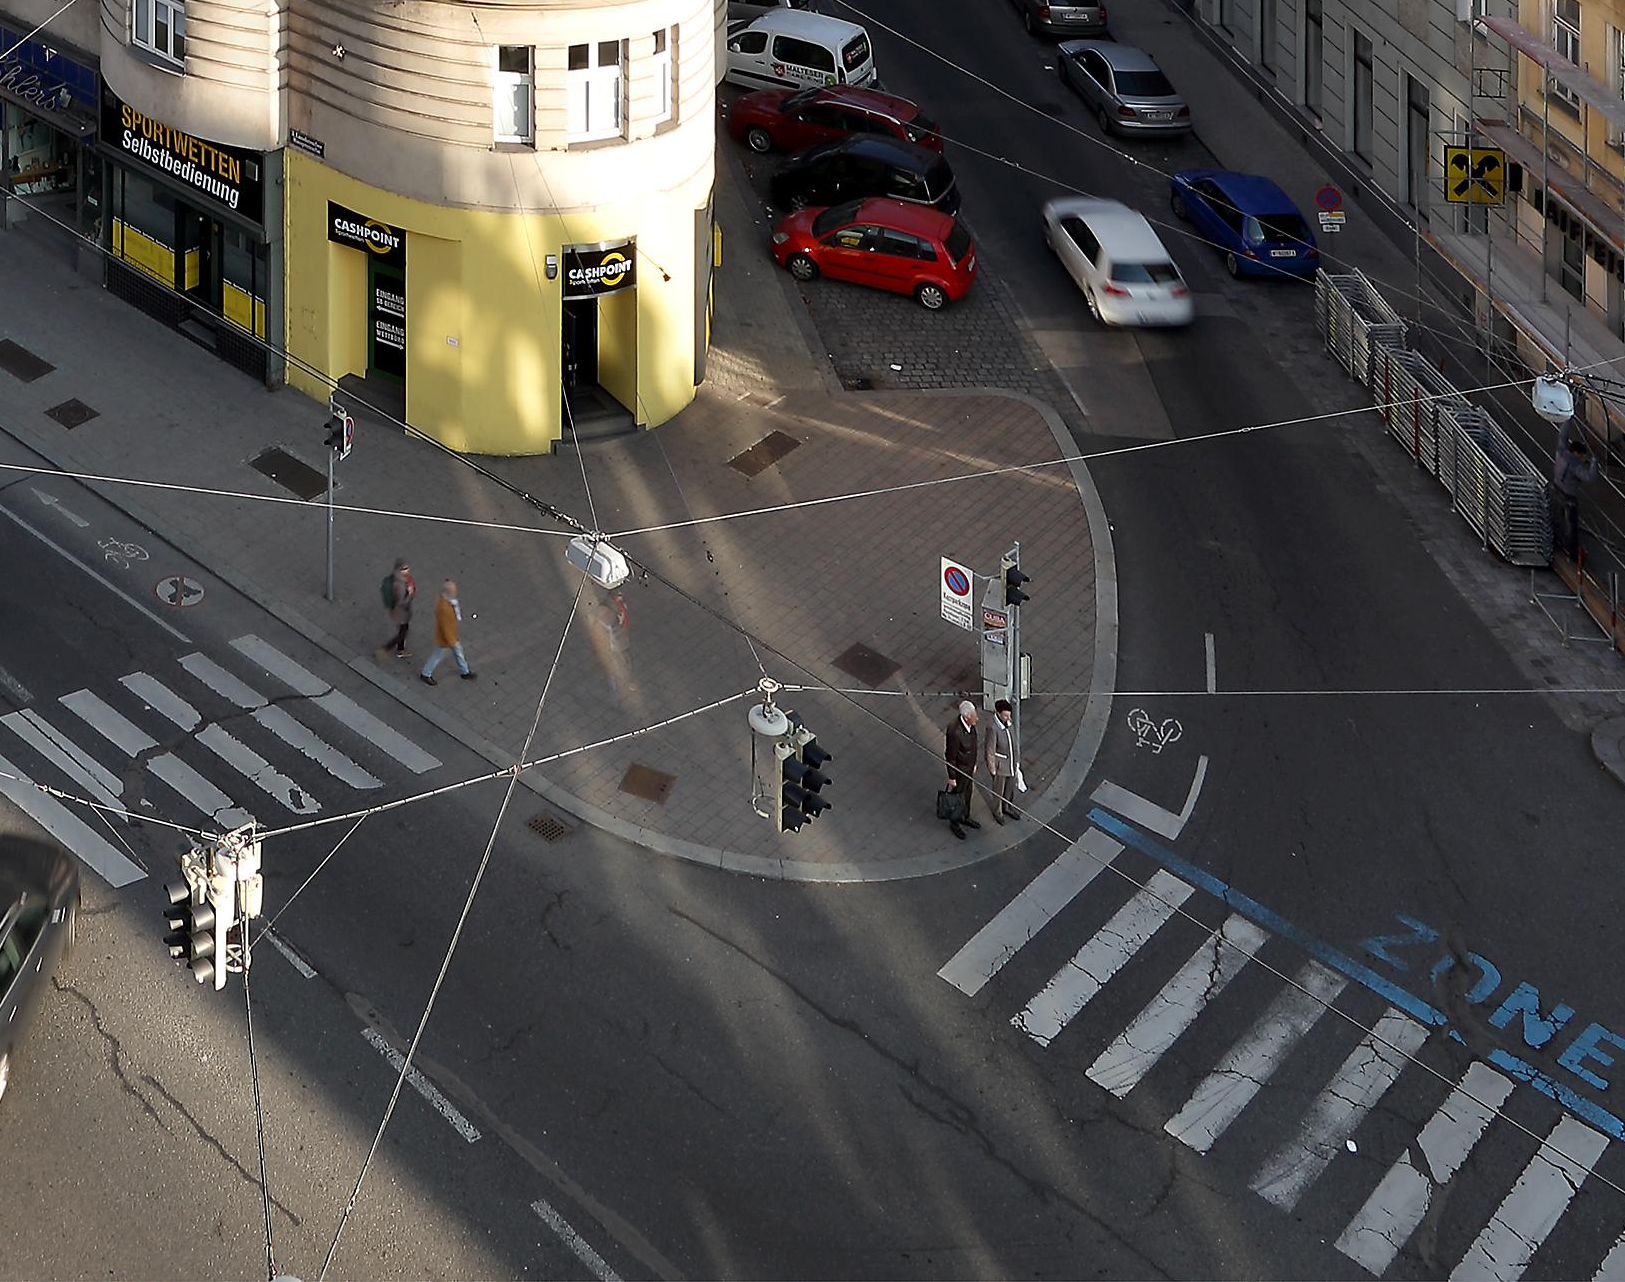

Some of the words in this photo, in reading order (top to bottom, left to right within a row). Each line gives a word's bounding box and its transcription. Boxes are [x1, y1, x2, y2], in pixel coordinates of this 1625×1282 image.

[121, 104, 240, 184] SPORTWETTEN
[122, 129, 240, 209] Selbstbedienung
[334, 218, 400, 248] CASHPOINT
[569, 259, 632, 280] CASHPOINT
